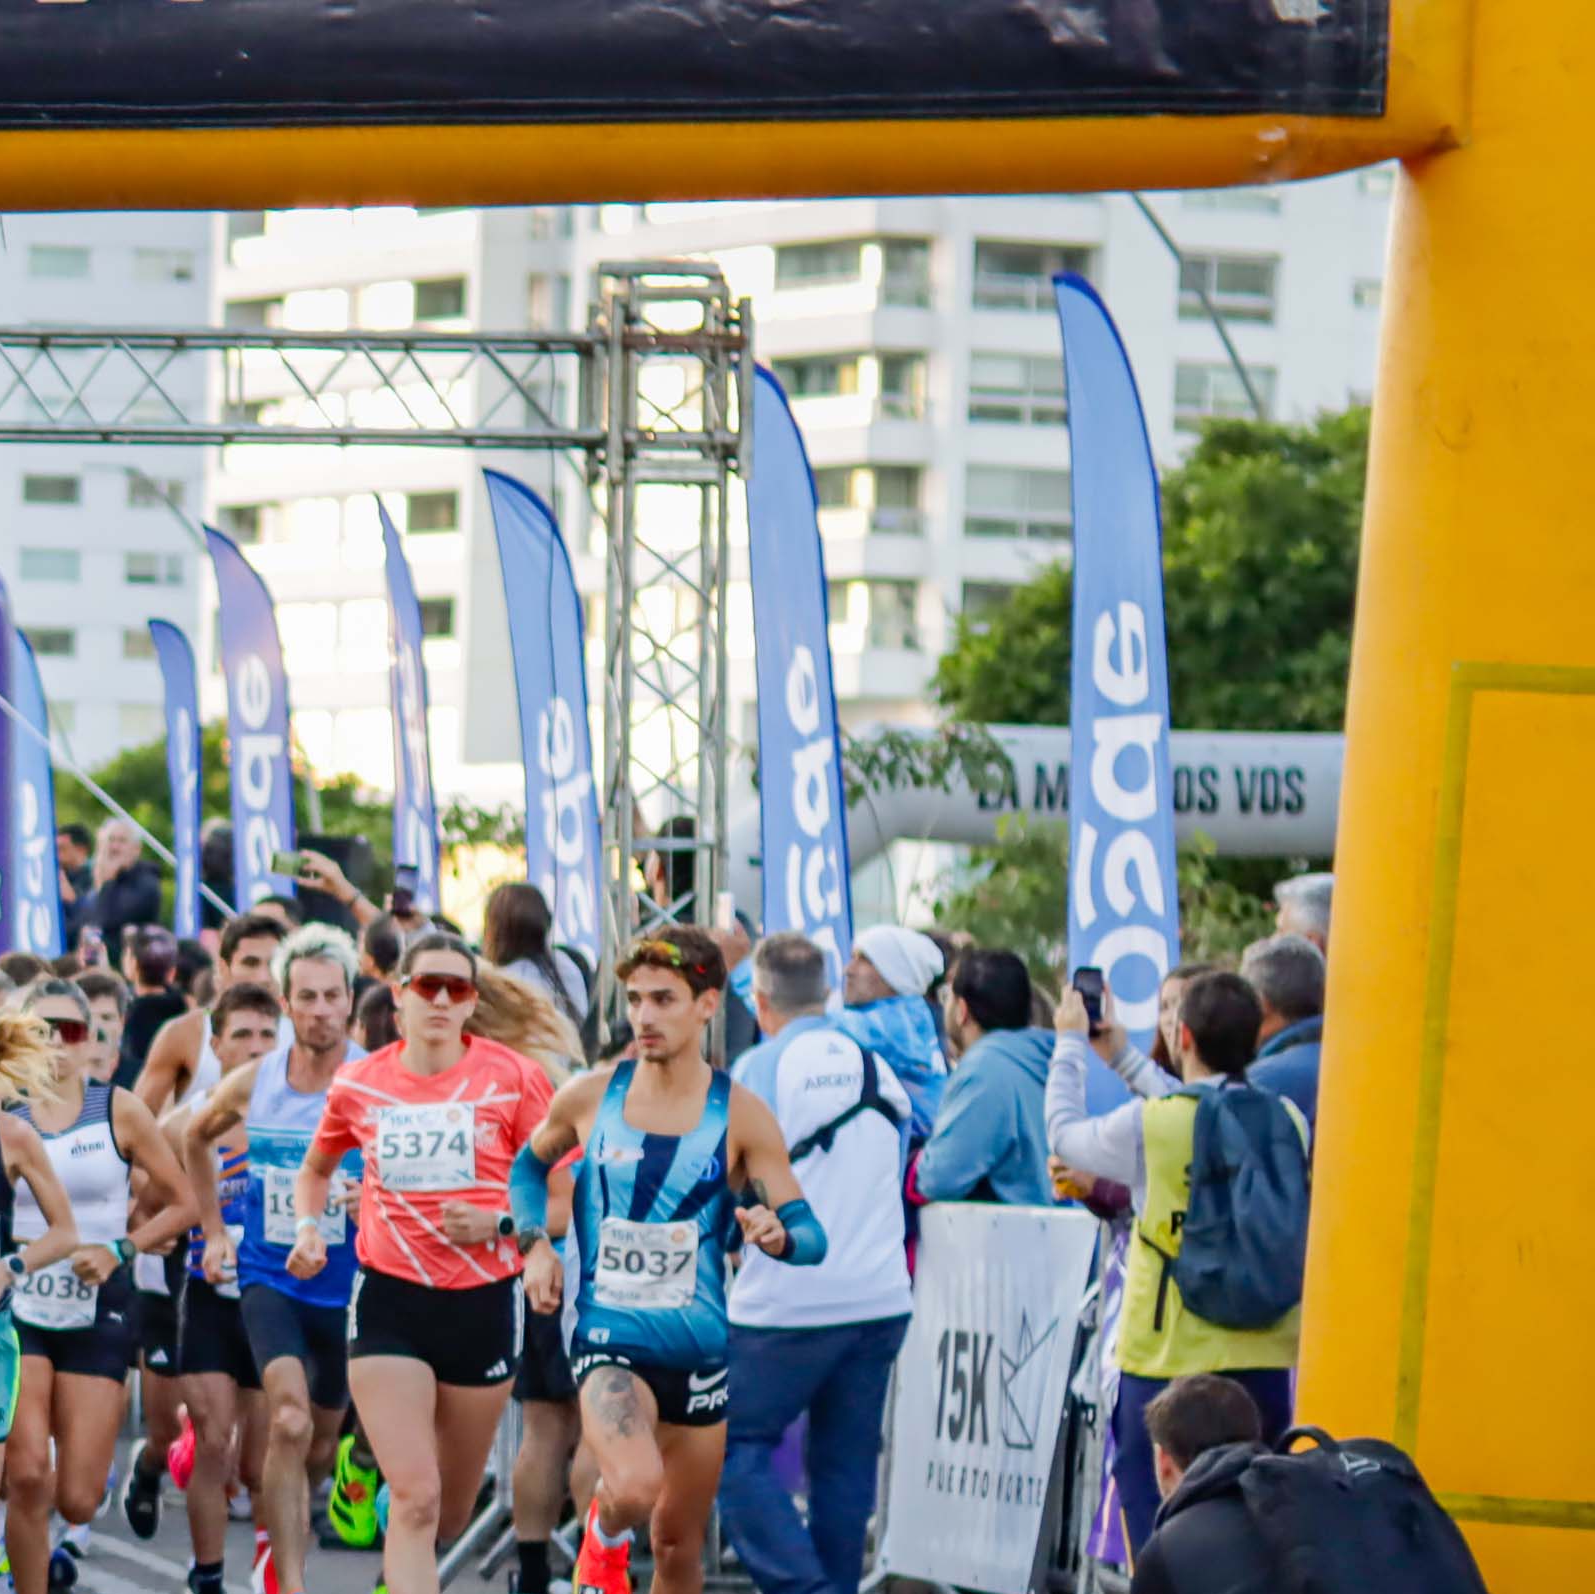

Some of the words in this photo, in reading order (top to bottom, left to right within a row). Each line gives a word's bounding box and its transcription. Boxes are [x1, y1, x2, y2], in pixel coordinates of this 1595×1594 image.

[1173, 765, 1220, 814] OS
[1234, 766, 1306, 816] VOS
[381, 1130, 469, 1160] 5374
[601, 1245, 693, 1278] 5037
[935, 1328, 995, 1447] 15K
